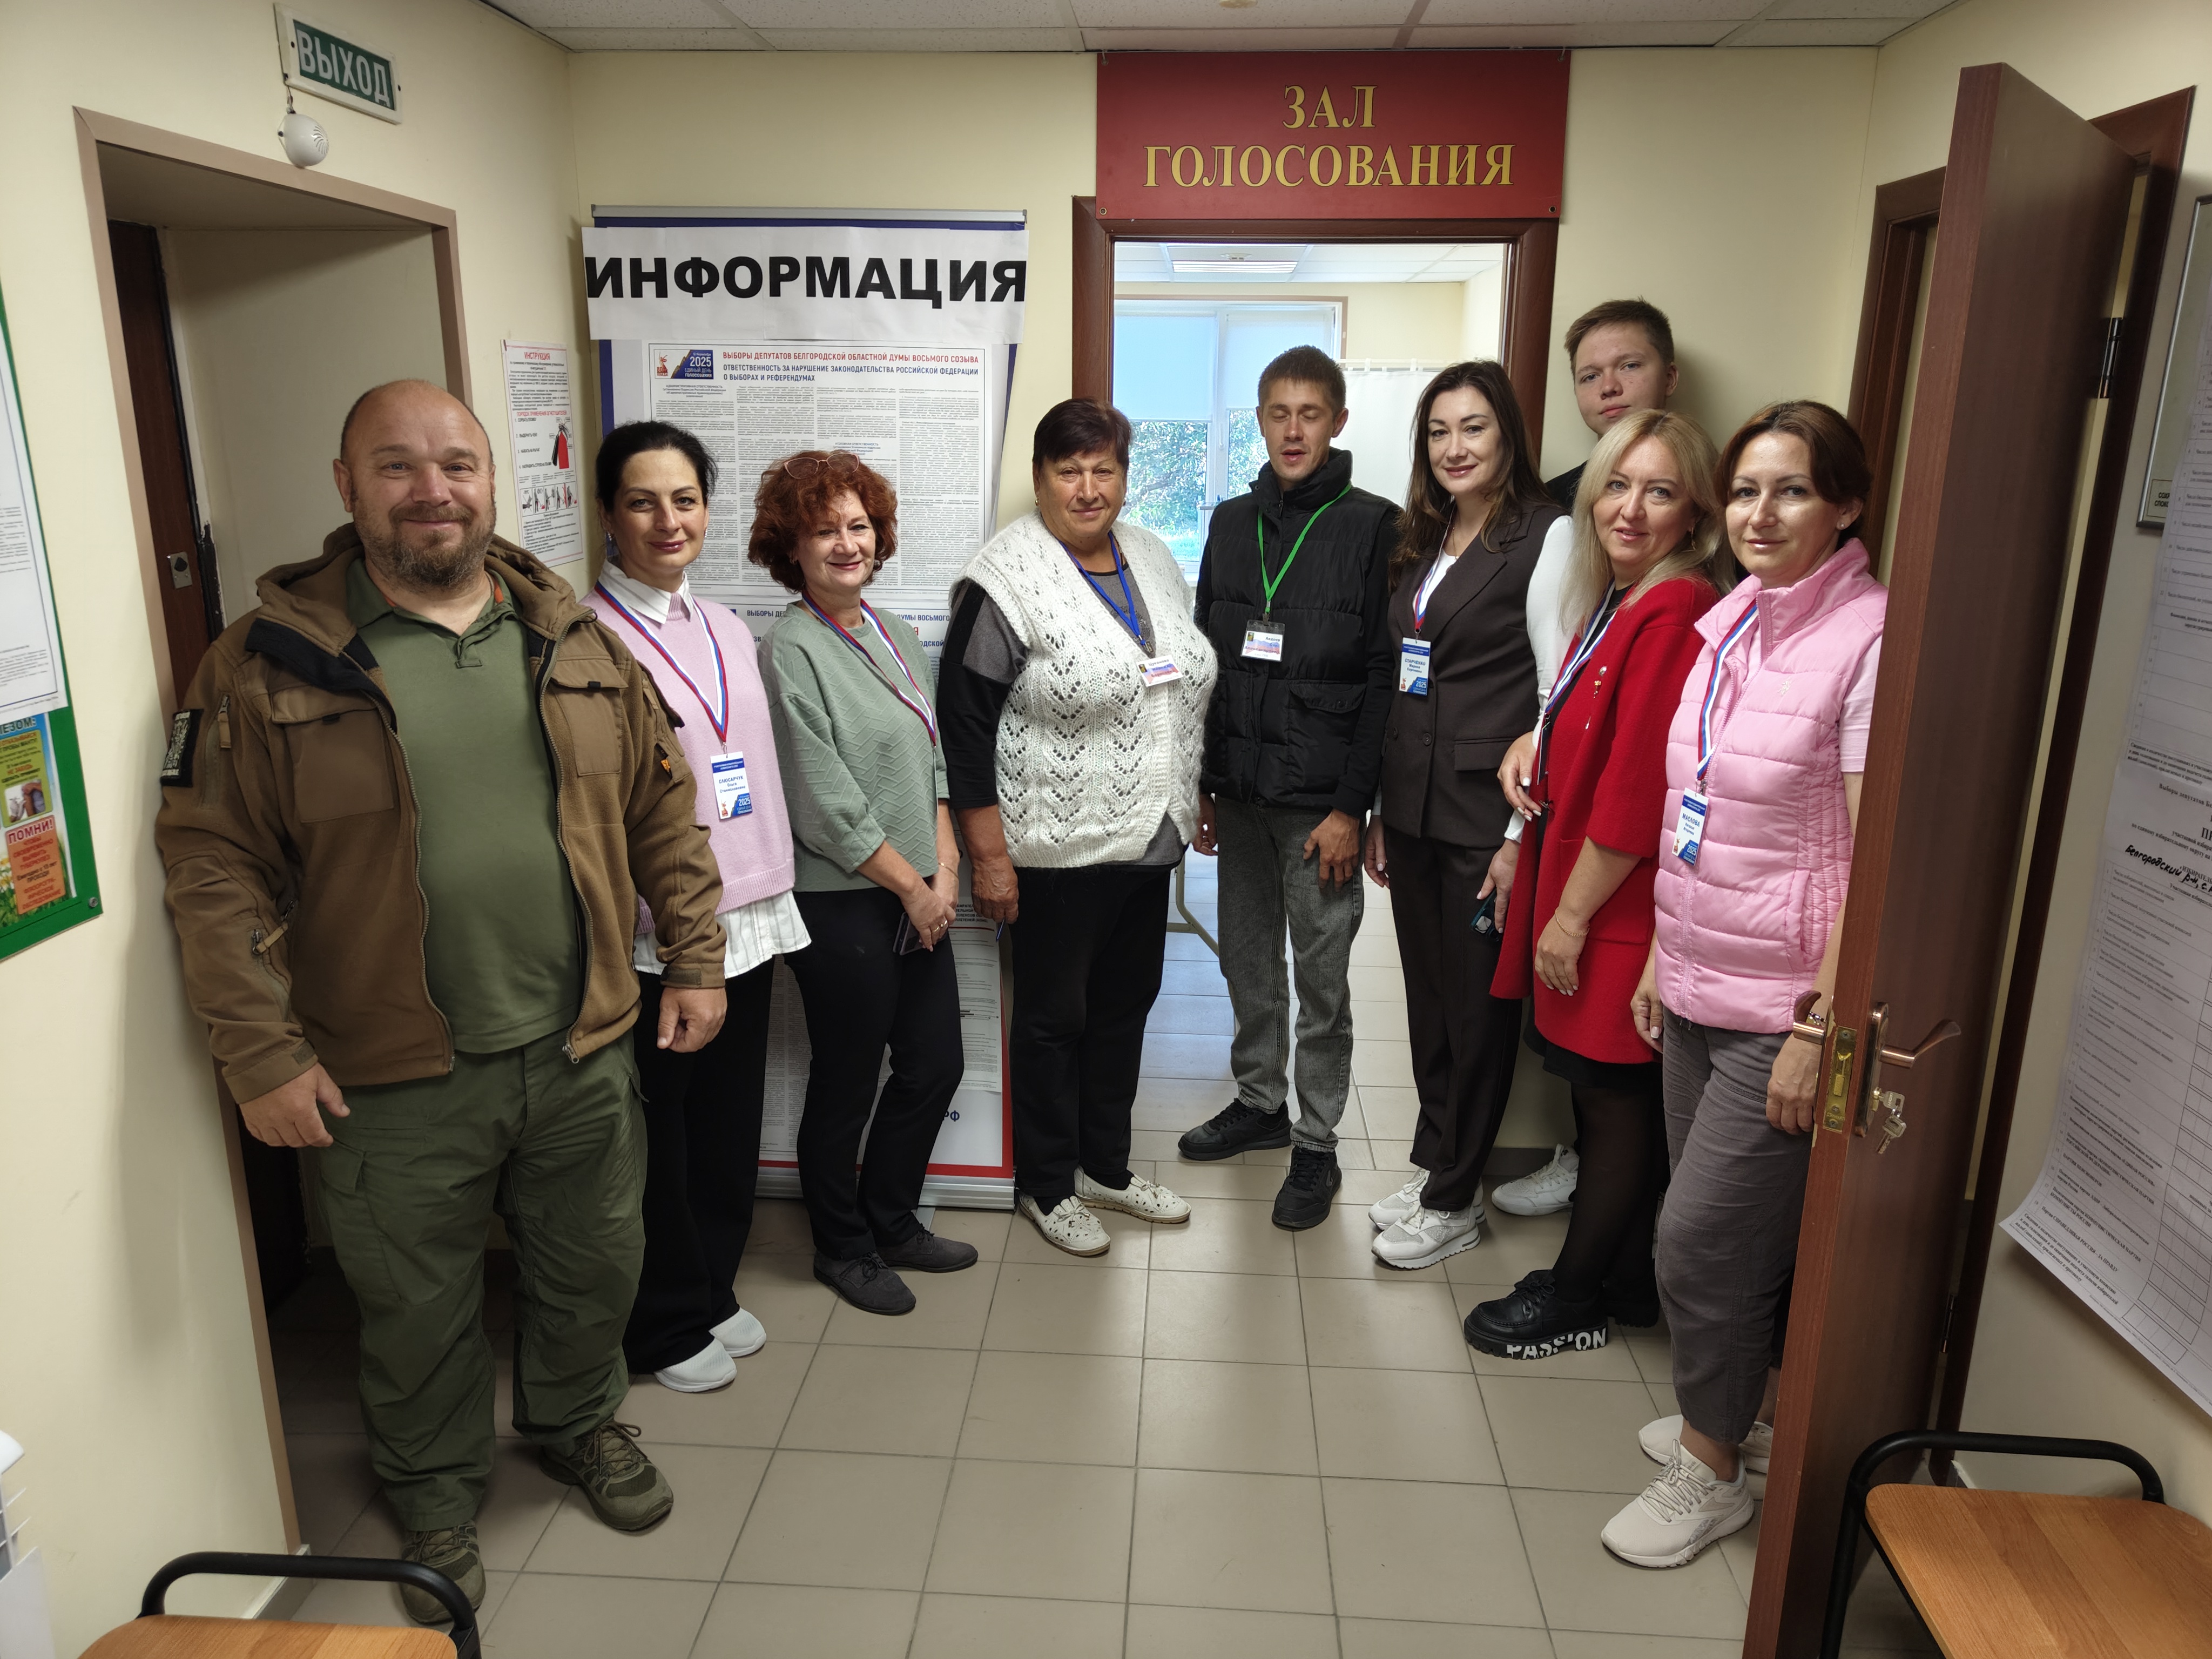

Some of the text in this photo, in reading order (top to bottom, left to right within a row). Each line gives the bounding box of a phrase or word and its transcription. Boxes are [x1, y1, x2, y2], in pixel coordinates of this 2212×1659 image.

[297, 29, 391, 107] ВЫХОД
[1283, 85, 1377, 129] ЗАЛ
[1143, 144, 1515, 187] ГОЛОСОВАНИЯ
[585, 256, 1027, 309] ИНФОРМАЦИЯ
[690, 356, 712, 367] 2025
[794, 352, 846, 361] БЕЛГОРОДСКОЙ
[848, 353, 887, 361] ОБЛАСТНОЙ
[950, 355, 979, 363] СОЗЫВА
[831, 366, 894, 374] ЗАКОНОДАТЕЛЬСТВА
[896, 366, 938, 374] РОССИЙСКОЙ
[1416, 680, 1427, 689] 2025
[2159, 783, 2178, 796] Выборы
[738, 797, 751, 806] 2025
[1682, 813, 1700, 827] МАСЛОВА
[9, 819, 53, 844] ПОМНИ!
[1687, 844, 1697, 856] 2025
[1507, 1327, 1607, 1359] PASSION
